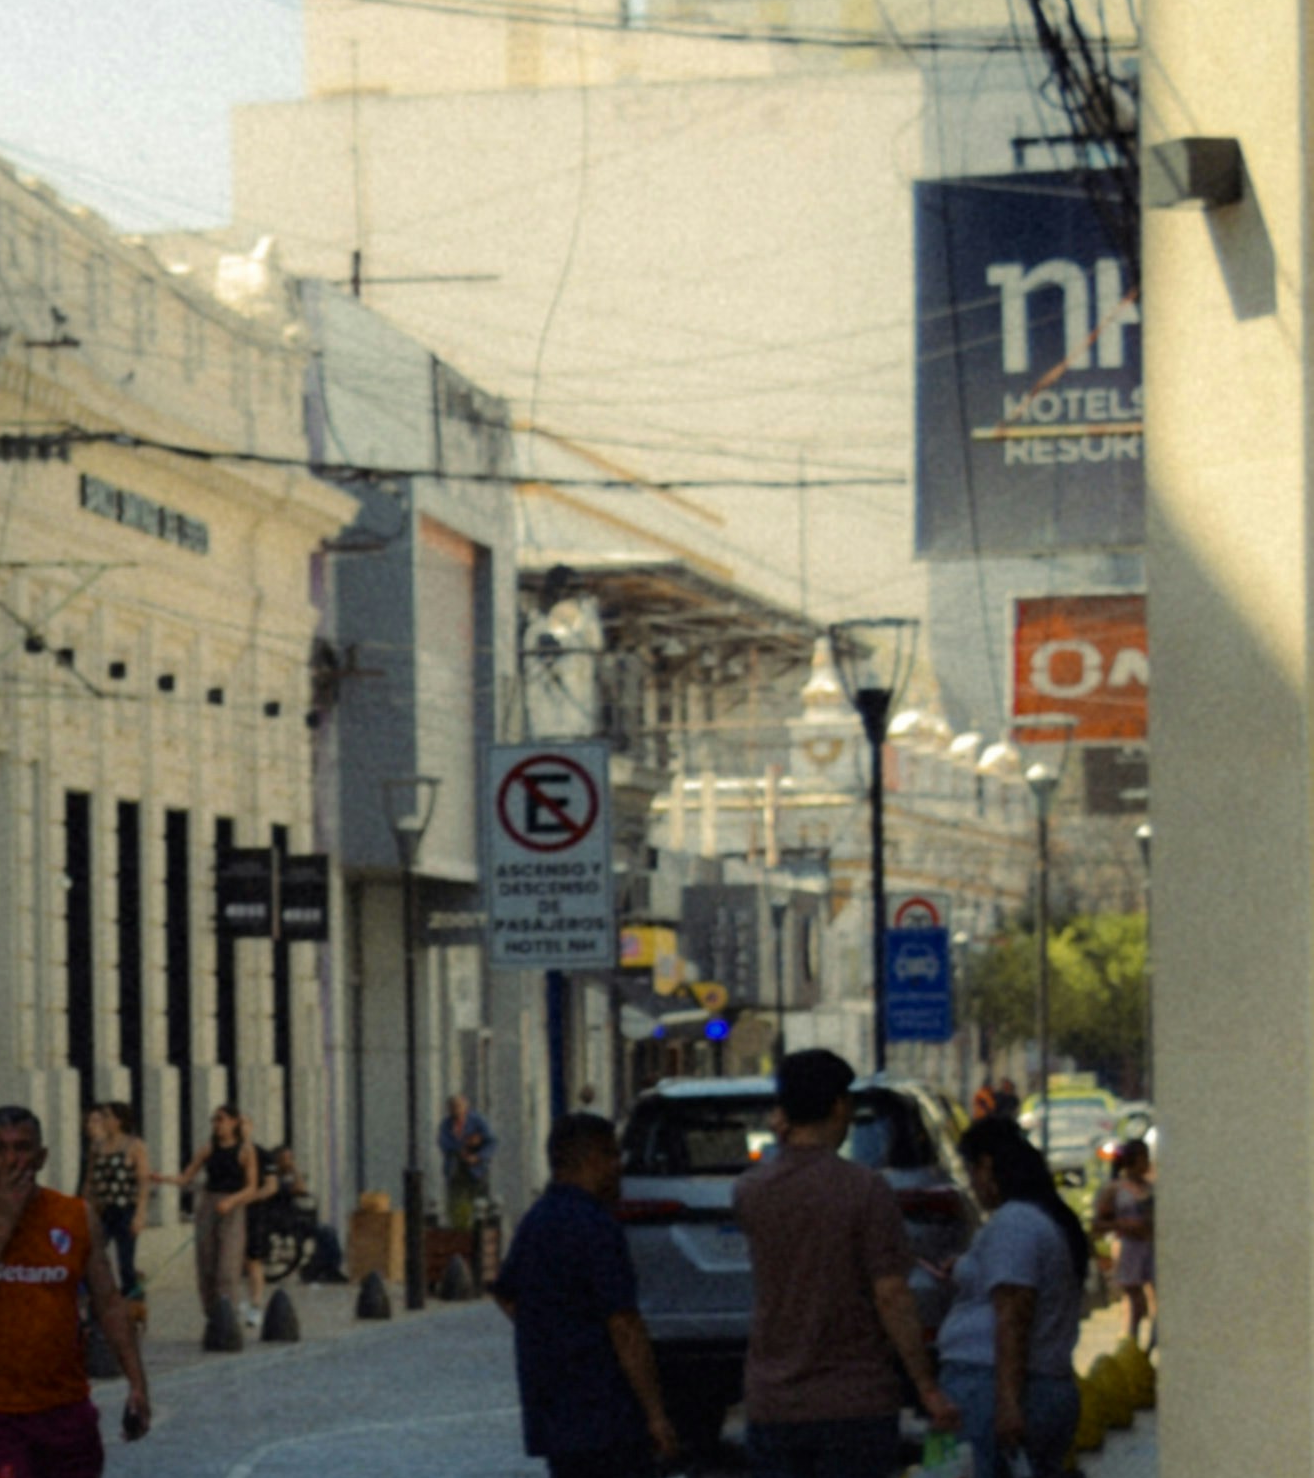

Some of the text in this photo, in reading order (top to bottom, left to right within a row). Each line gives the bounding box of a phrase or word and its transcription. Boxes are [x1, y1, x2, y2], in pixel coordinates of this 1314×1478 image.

[1003, 432, 1142, 467] RESOR
[496, 862, 586, 878] ASCENSO
[499, 880, 599, 896] DESCENSO
[538, 899, 560, 914] DE
[494, 917, 606, 932] PASAJEROS
[504, 938, 597, 954] HOTEL NH
